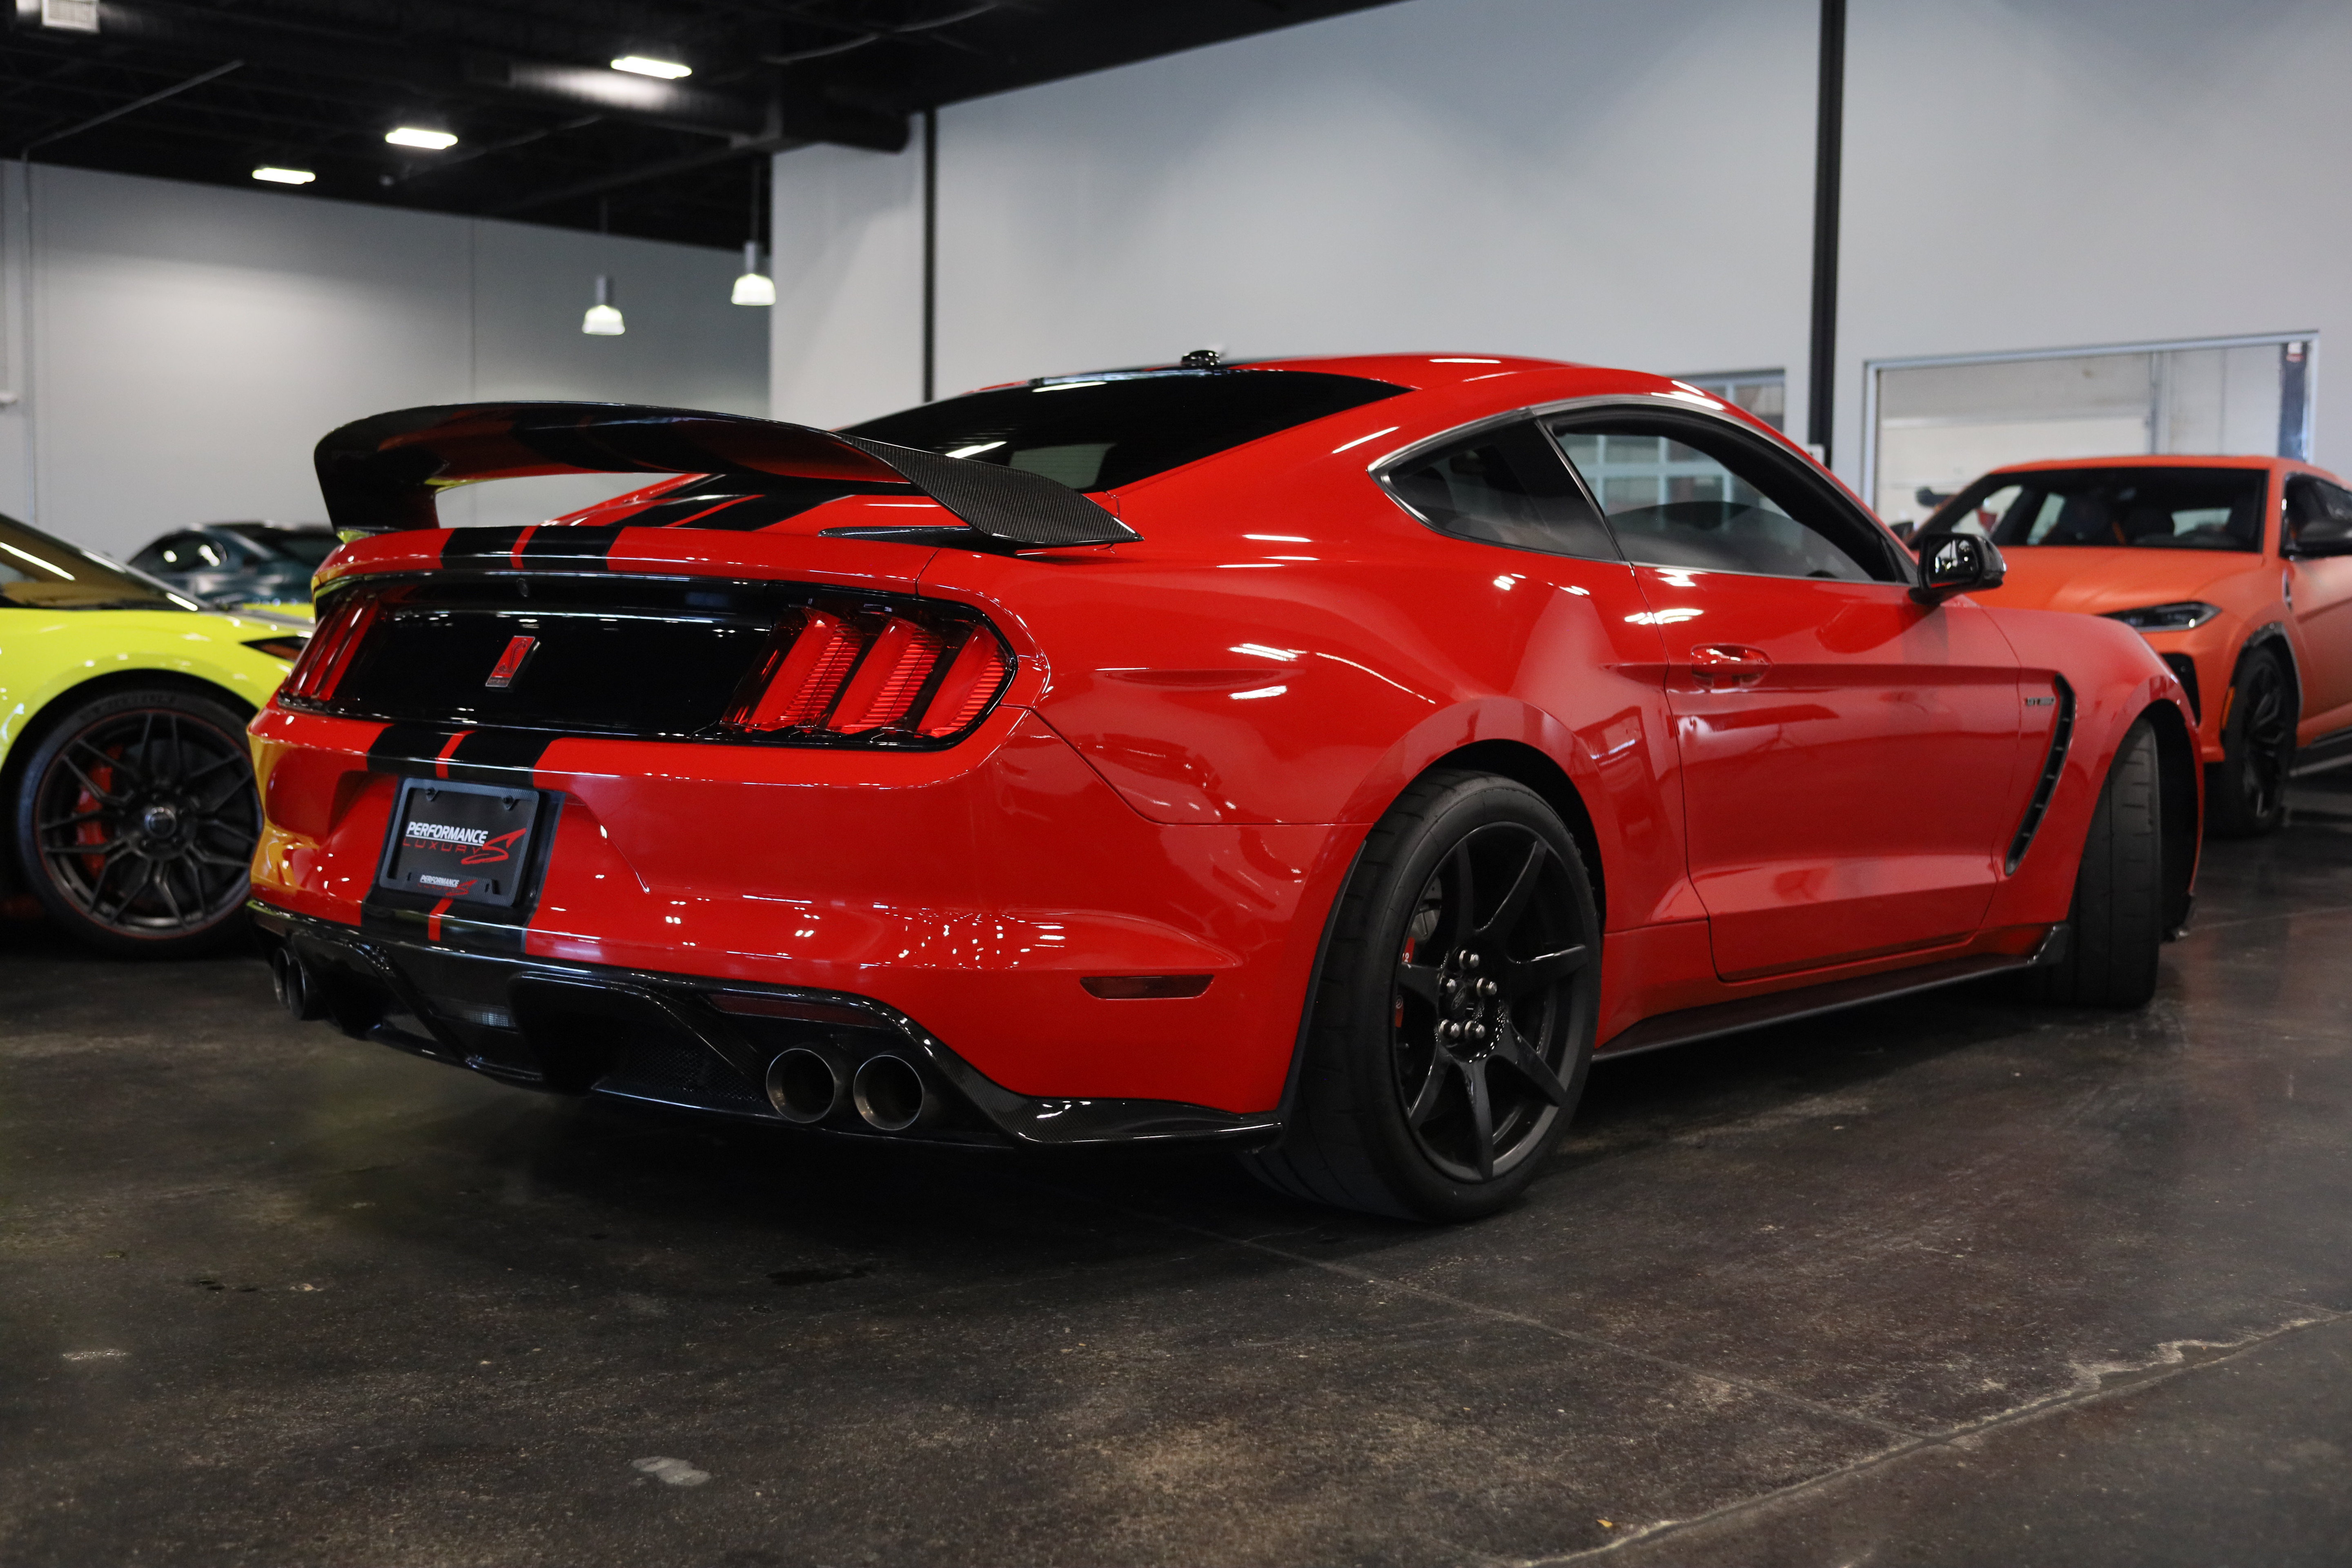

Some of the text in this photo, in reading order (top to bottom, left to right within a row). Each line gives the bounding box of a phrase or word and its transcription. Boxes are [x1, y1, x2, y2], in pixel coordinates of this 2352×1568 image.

[406, 821, 488, 844] PERFORMANCE
[403, 838, 481, 855] LUXURY
[420, 875, 460, 887] PERFORMANCE
